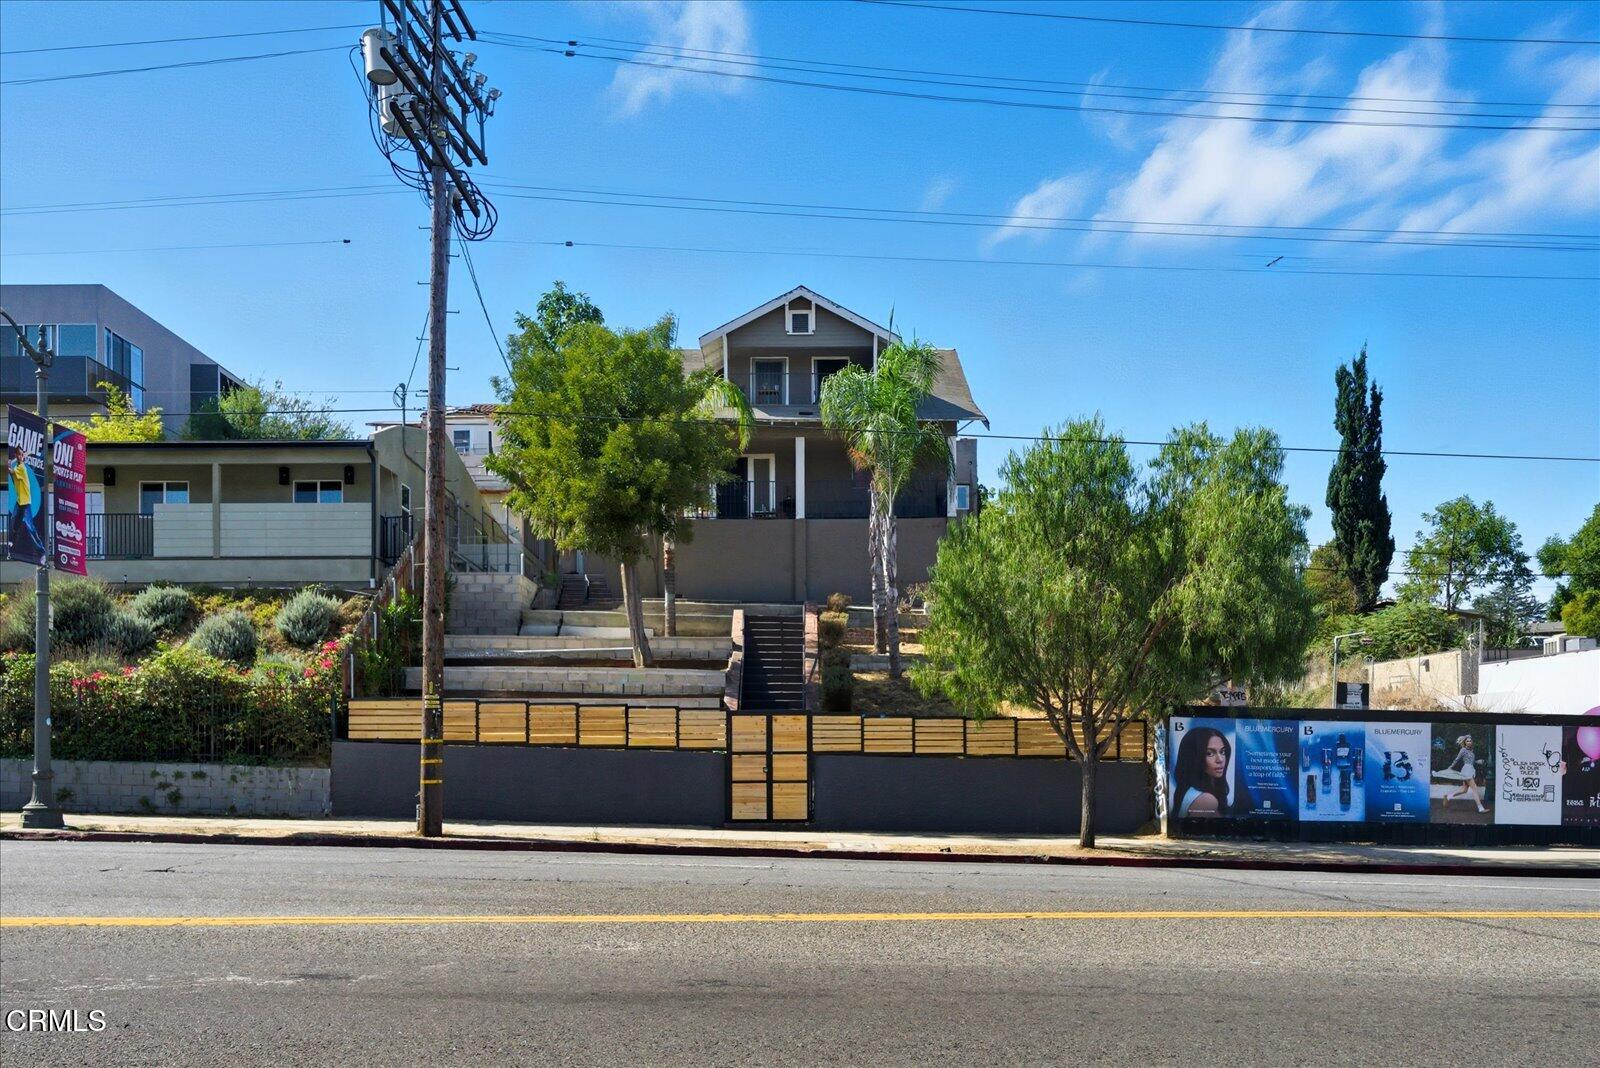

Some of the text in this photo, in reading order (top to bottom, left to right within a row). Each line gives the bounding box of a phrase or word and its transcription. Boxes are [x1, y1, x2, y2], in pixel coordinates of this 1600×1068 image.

[8, 423, 44, 457] GAME
[53, 440, 74, 468] ON!
[53, 464, 69, 478] SPORTS
[1245, 725, 1293, 733] BLUEMERCURY
